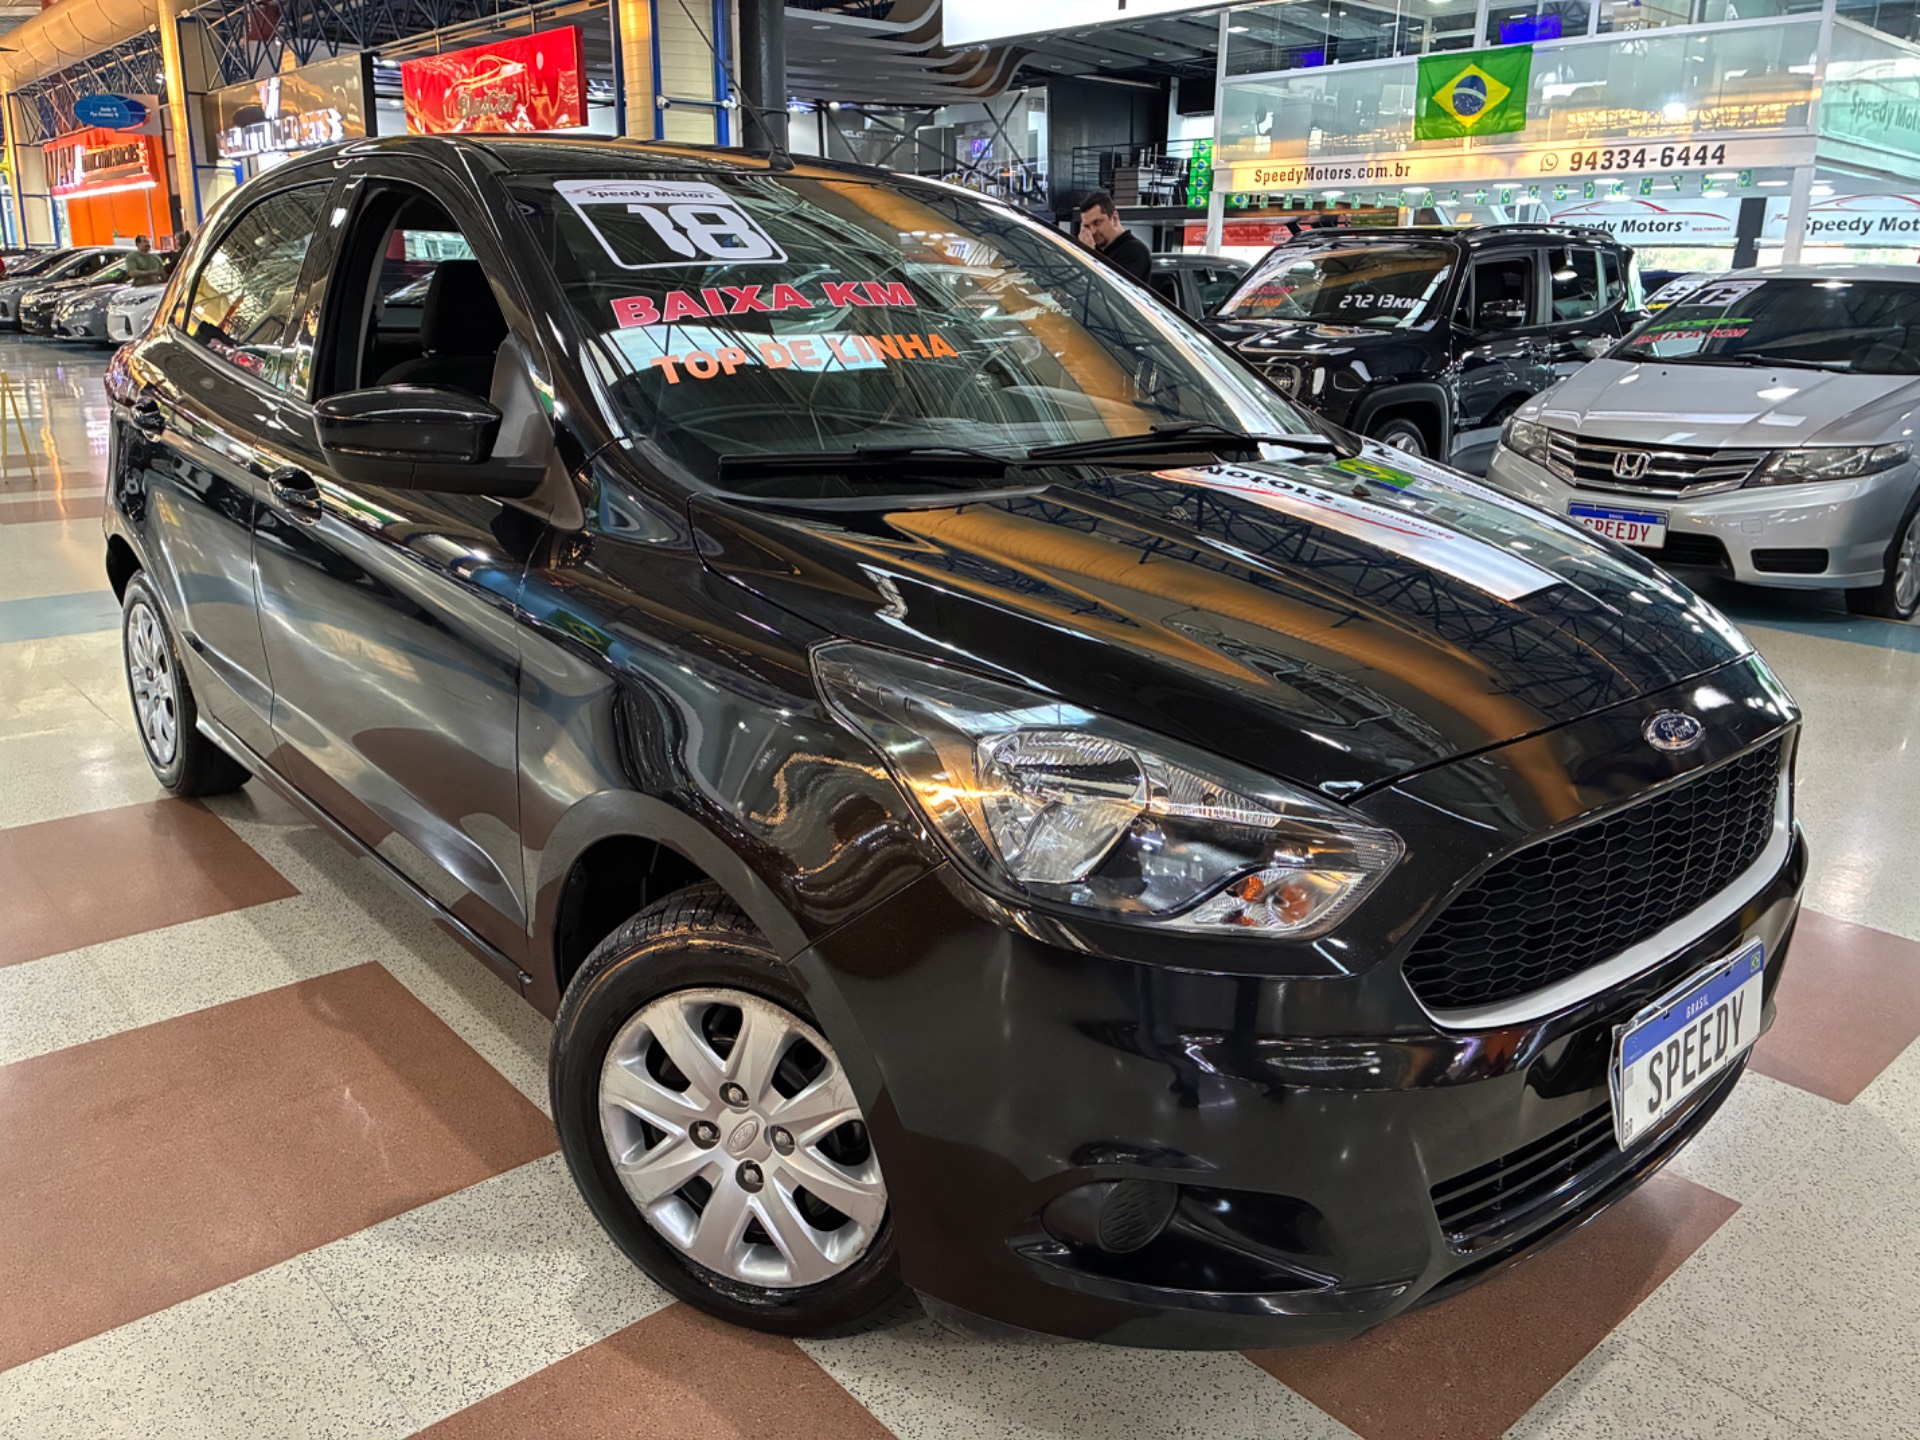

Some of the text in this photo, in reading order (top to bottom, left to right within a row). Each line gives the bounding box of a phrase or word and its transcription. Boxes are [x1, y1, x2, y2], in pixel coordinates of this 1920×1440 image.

[1850, 90, 1920, 133] Speedy Mot
[1254, 162, 1411, 185] SpeedyMotors.com.br
[1569, 144, 1726, 171] 94334-6444
[586, 190, 715, 199] Speedy Motors
[627, 204, 773, 259] 18
[610, 281, 918, 329] BAIXA KM
[1632, 328, 1750, 345] BAIXA KM
[650, 334, 960, 384] TOP DE LINHA
[1686, 994, 1709, 1019] BRASIL
[1648, 989, 1745, 1114] SPEEDY
